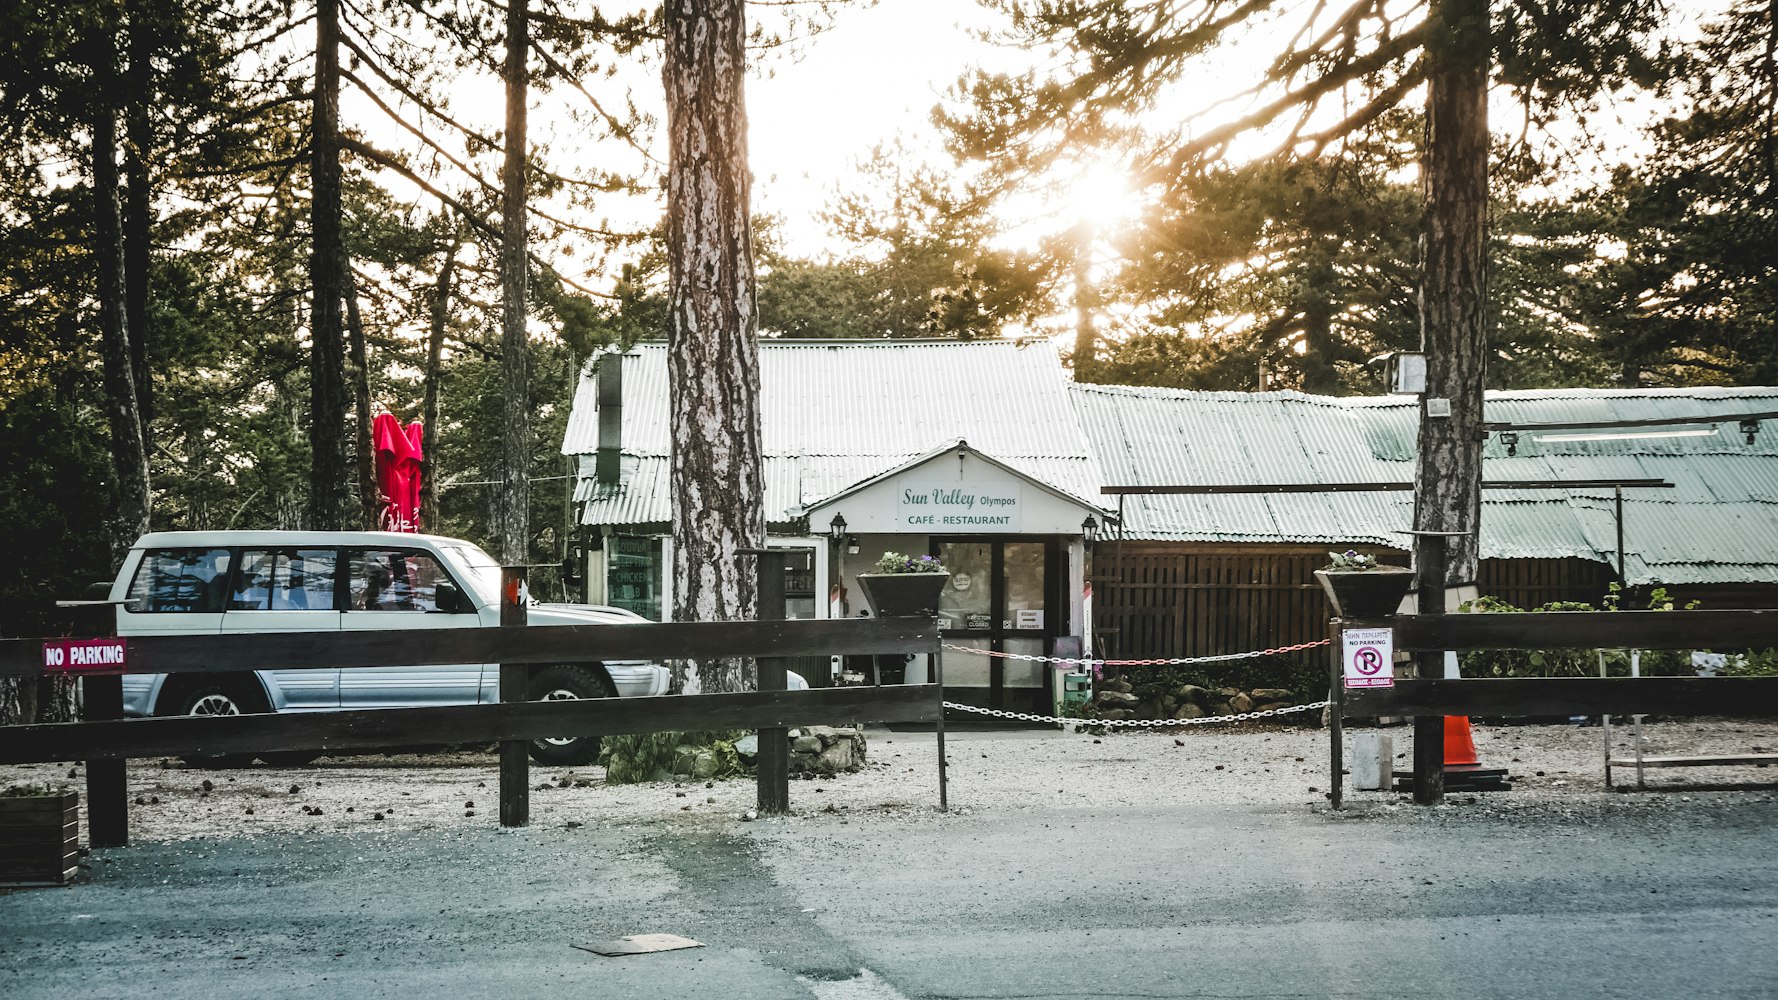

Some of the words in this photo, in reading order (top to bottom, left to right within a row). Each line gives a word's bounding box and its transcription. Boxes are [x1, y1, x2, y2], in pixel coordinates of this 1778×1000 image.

[903, 488, 928, 505] Sun
[932, 488, 976, 510] Valley
[980, 496, 1016, 507] Olympos
[908, 515, 935, 525] CAFÉ
[943, 516, 1010, 525] RESTAURANT
[46, 648, 64, 666] NO
[70, 645, 124, 664] PARKING
